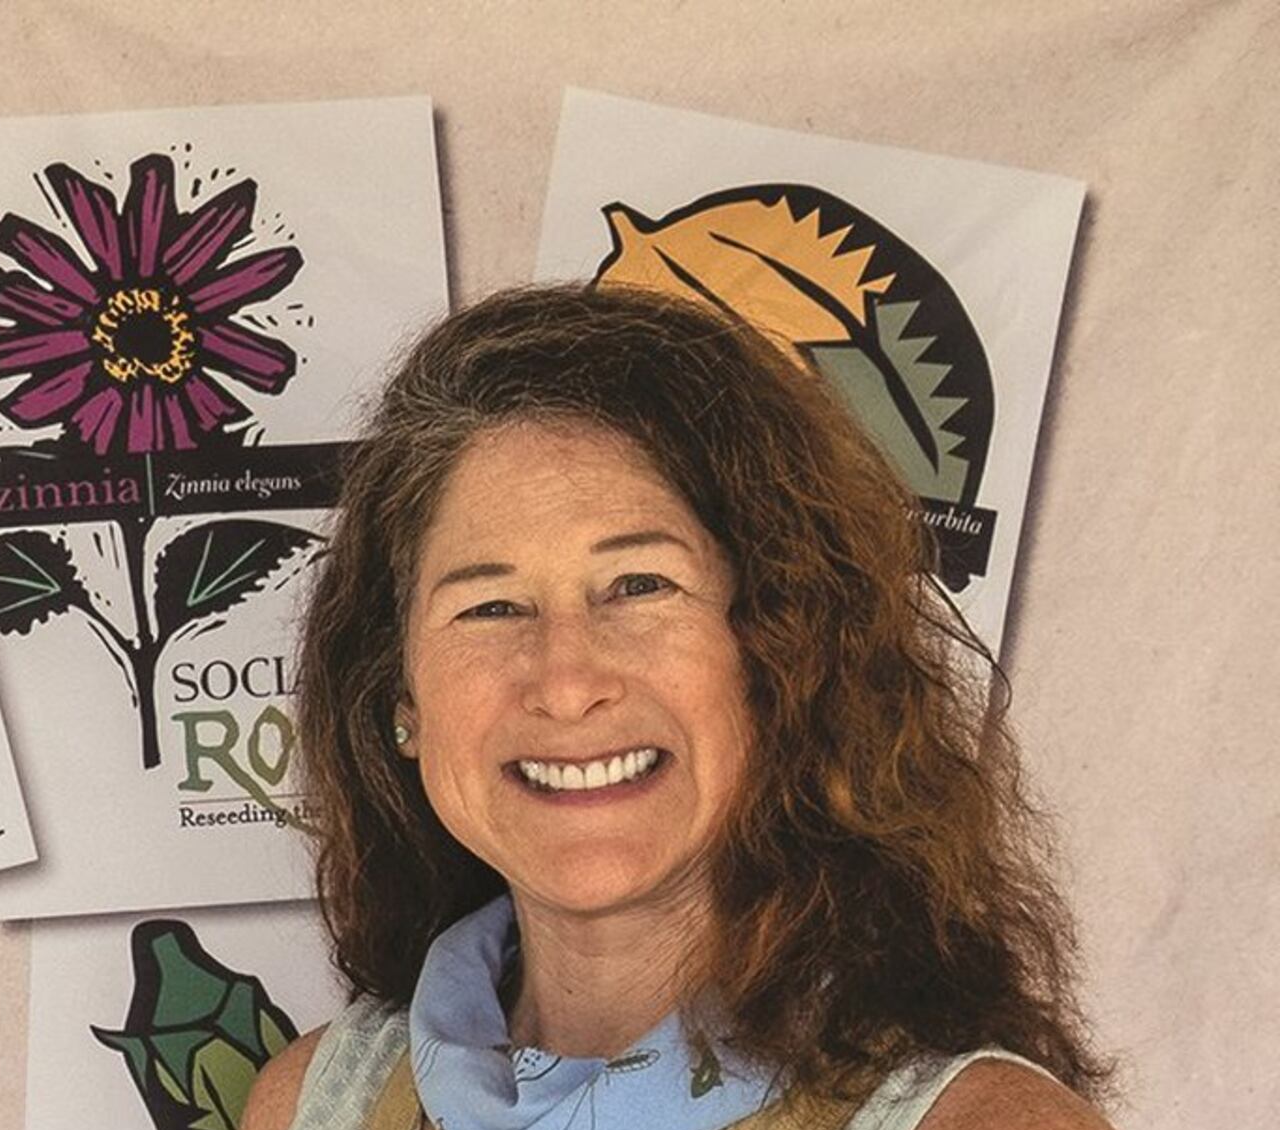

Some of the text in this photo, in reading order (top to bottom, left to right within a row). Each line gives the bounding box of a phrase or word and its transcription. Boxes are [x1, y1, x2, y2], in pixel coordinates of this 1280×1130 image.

[163, 469, 302, 500] Zinnia elegans
[179, 803, 287, 829] Reseeding
